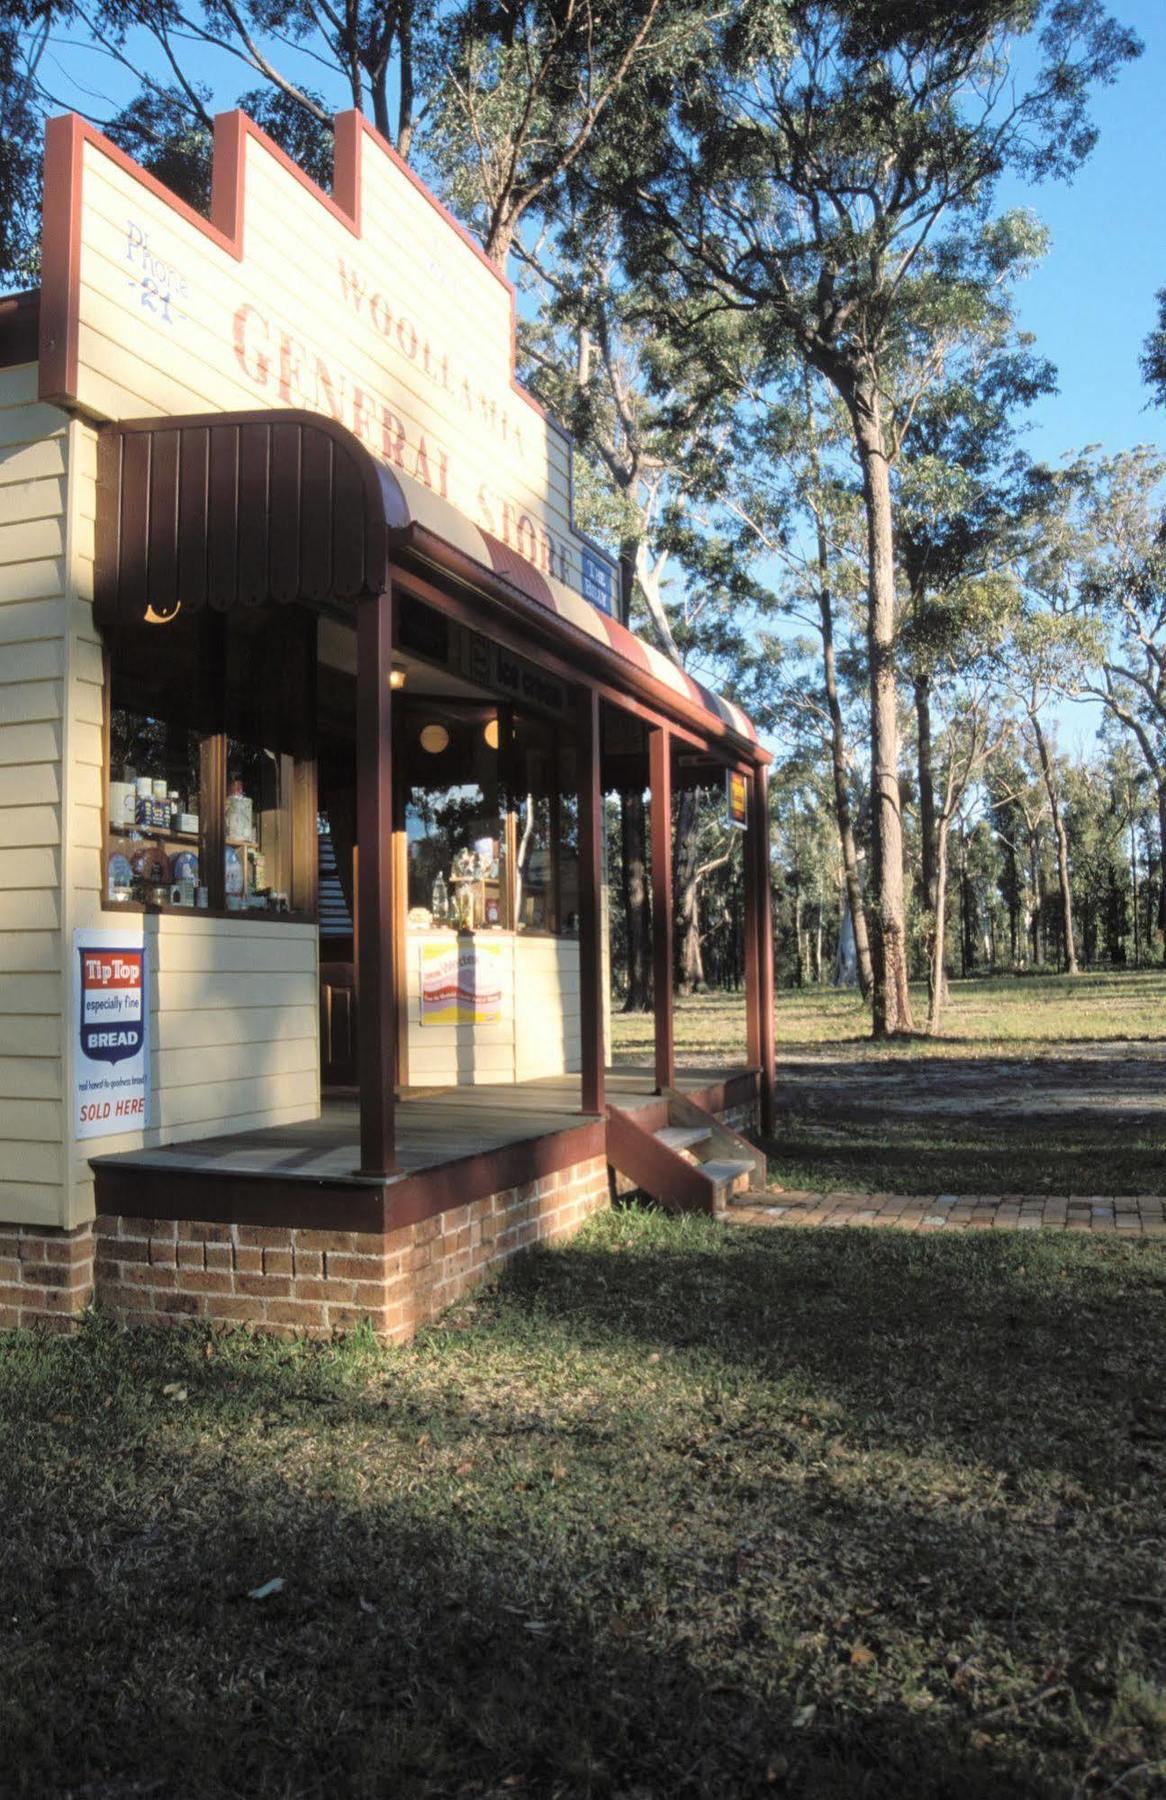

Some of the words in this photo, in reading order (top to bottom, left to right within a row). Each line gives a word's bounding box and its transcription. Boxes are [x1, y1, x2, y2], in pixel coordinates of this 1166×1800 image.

[232, 302, 449, 500] GENERAL
[477, 483, 573, 586] STORE
[86, 960, 112, 984] Tip
[112, 959, 140, 984] Top
[86, 996, 122, 1013] especially
[125, 994, 140, 1009] fine
[87, 1031, 138, 1049] BREAD
[80, 1102, 111, 1122] SOLD
[115, 1098, 146, 1116] HERE
